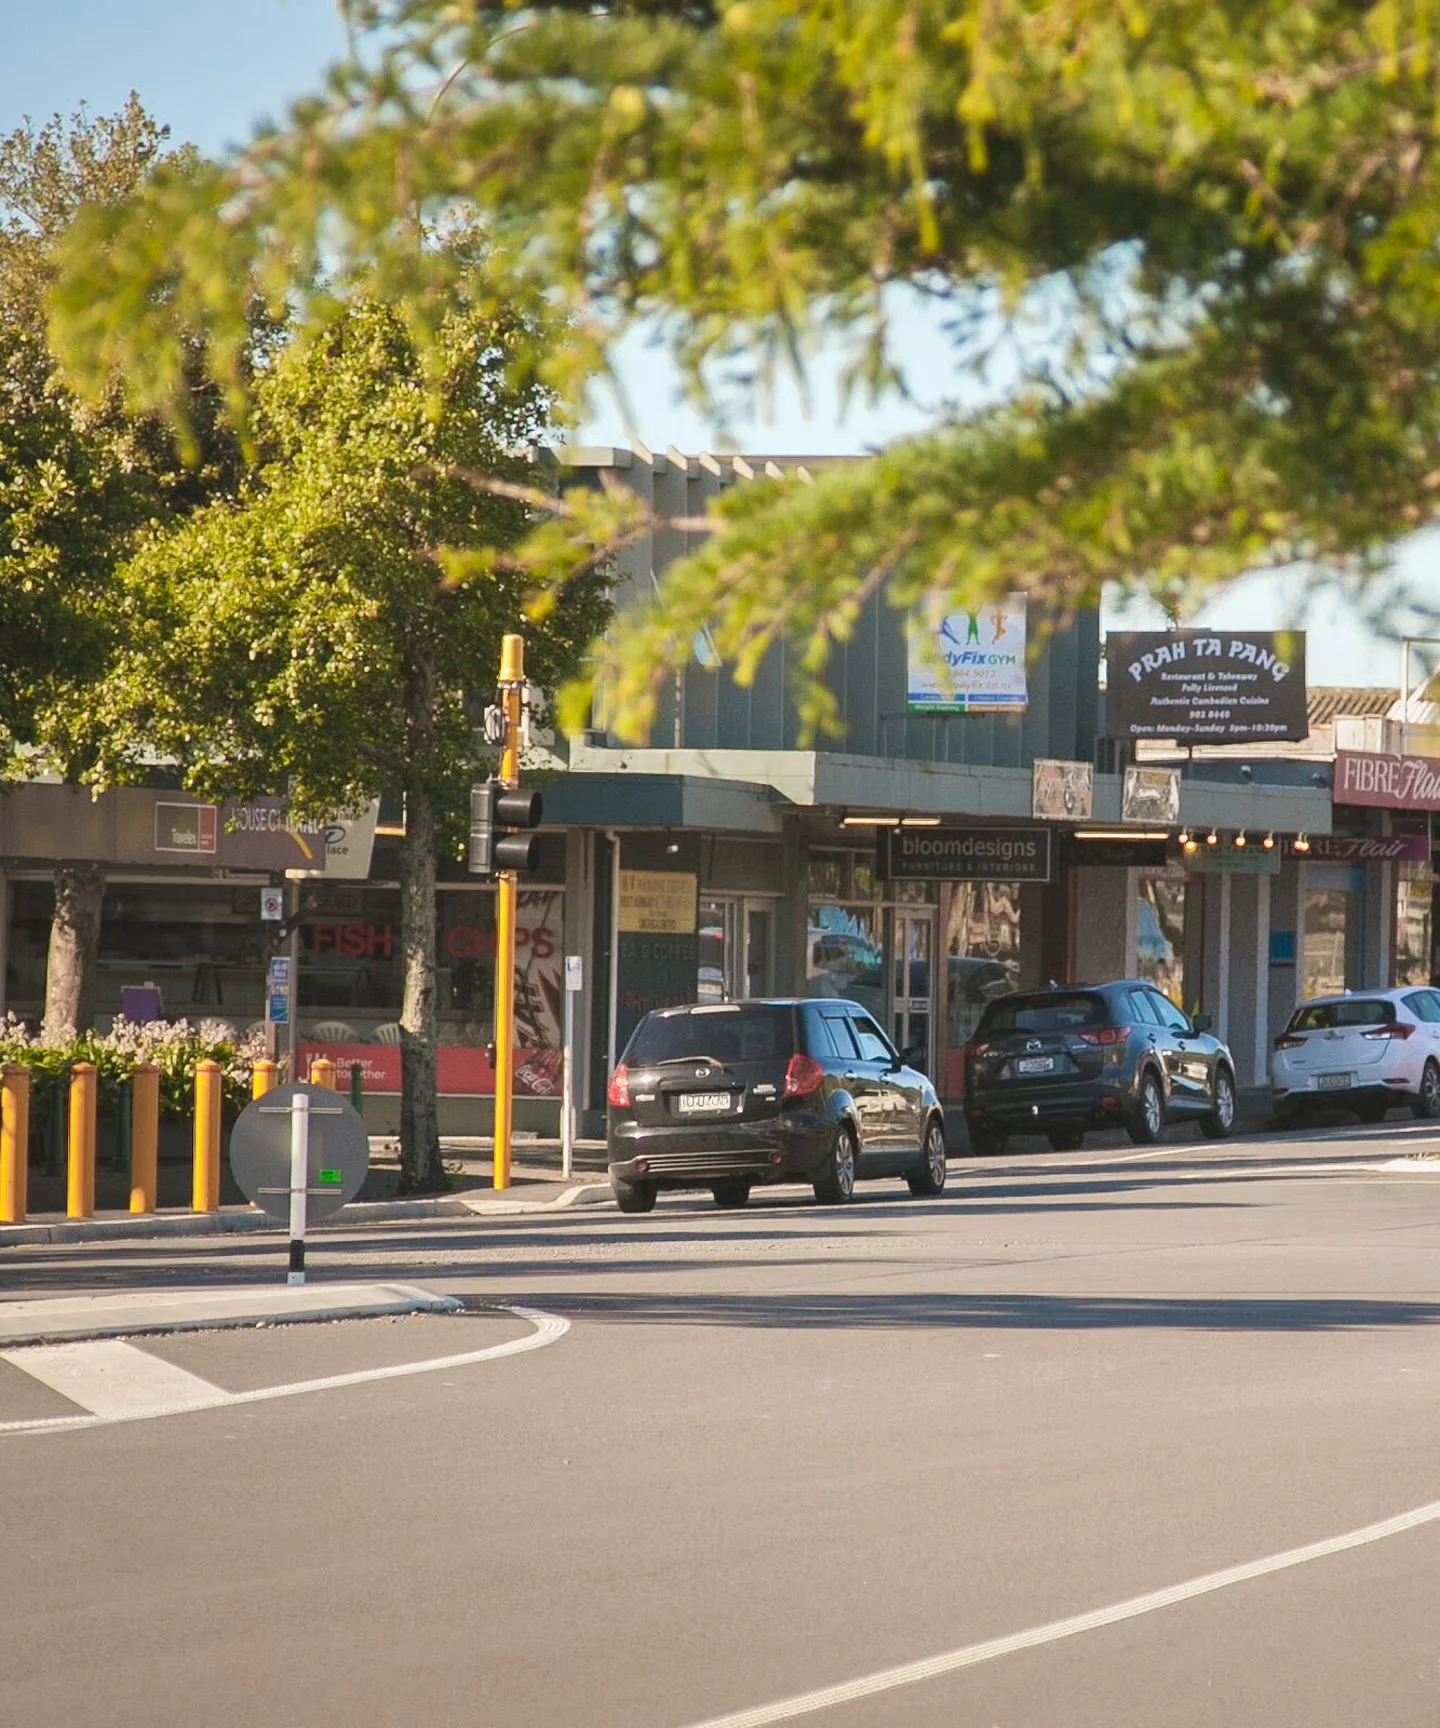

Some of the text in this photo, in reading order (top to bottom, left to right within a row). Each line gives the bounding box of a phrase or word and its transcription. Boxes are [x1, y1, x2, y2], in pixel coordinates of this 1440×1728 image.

[988, 655, 1016, 665] GYM
[1128, 638, 1290, 682] PRAH TA PANG
[1161, 672, 1258, 682] Restaurant & Takeaway
[1182, 683, 1202, 693] Fully
[1150, 697, 1270, 705] Authentic Cambodian Cuisine
[1130, 724, 1155, 733] Open:
[1343, 758, 1400, 793] FIBRE
[902, 836, 1037, 860] bloomdesigns
[1340, 838, 1408, 857] Flair
[977, 862, 1037, 872] INTERIORS
[313, 923, 554, 960] FISH CHPS
[336, 1057, 373, 1068] Better
[336, 1069, 386, 1082] togther
